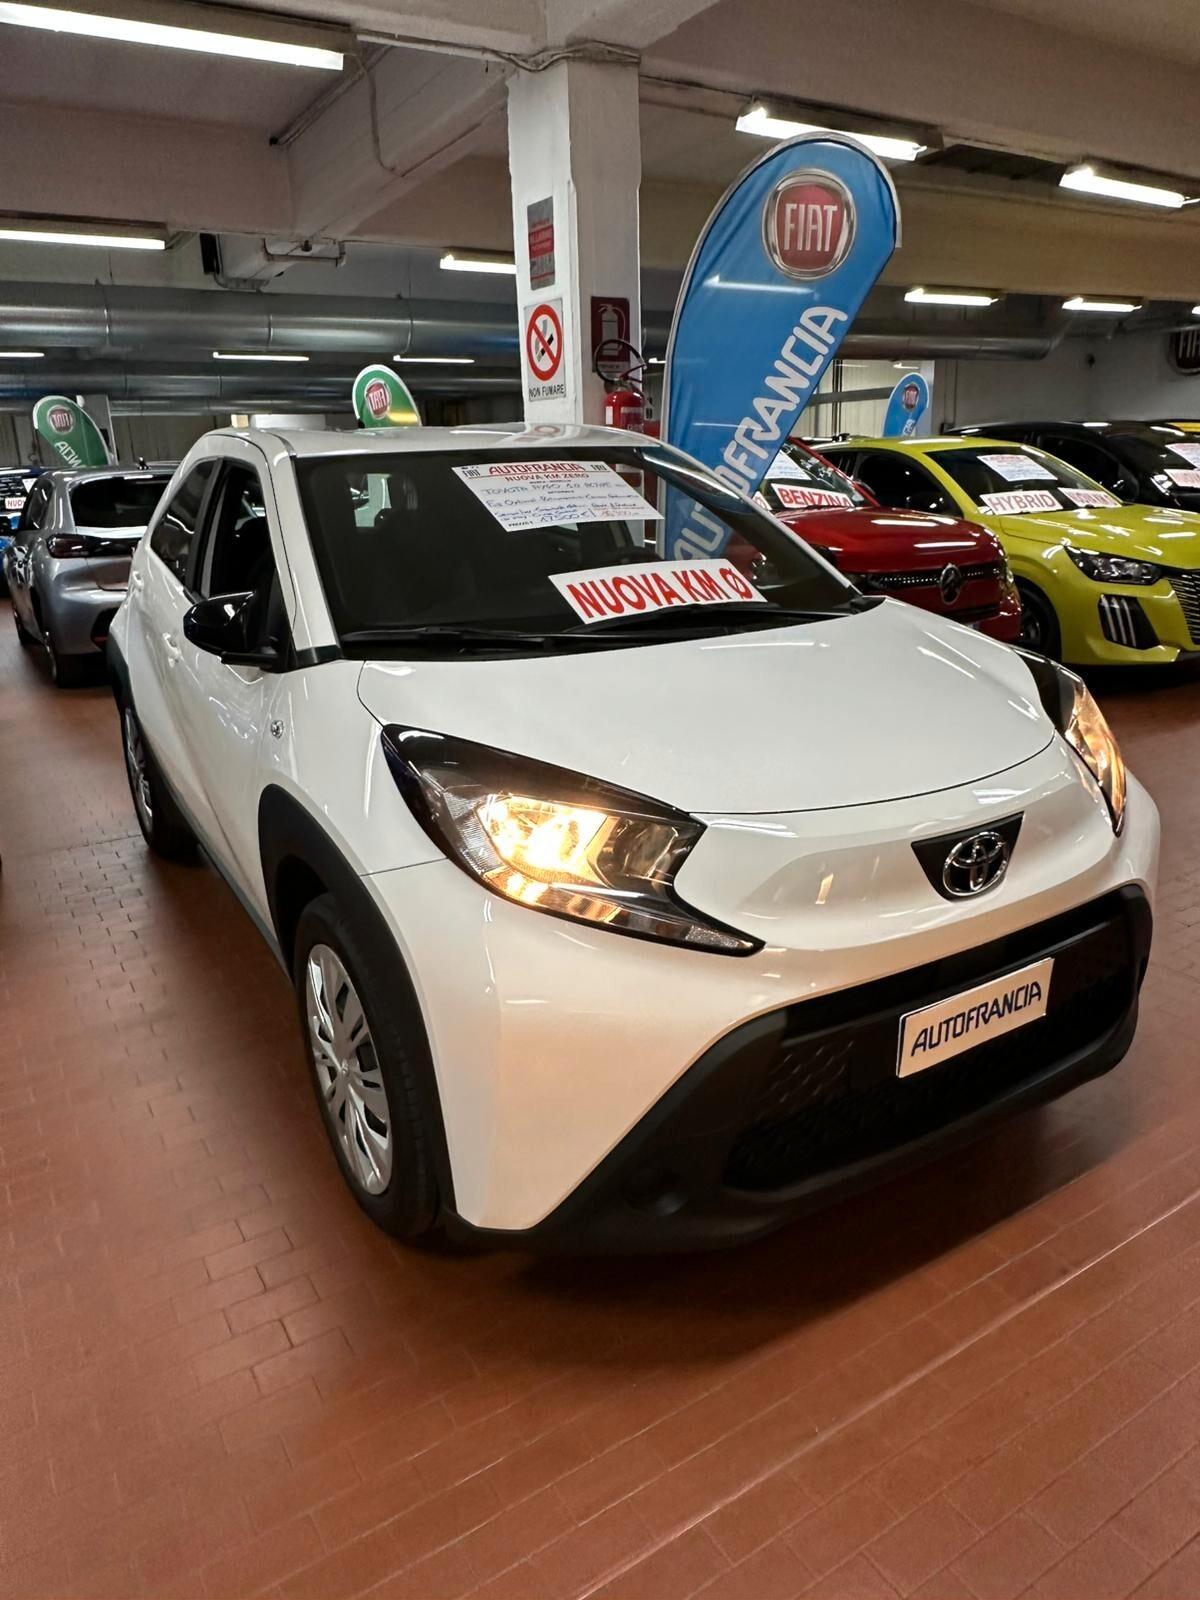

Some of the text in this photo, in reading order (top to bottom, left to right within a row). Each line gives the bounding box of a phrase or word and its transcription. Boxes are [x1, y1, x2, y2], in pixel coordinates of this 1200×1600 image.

[783, 203, 838, 252] FIAT
[529, 384, 564, 398] NON FUMARE
[488, 463, 586, 475] AUTOFRANCIA
[778, 487, 852, 507] BENZINA
[988, 493, 1056, 512] HYBRID
[566, 572, 687, 619] NUOVA
[672, 569, 732, 602] KM
[911, 981, 1042, 1057] AUTOFRANCIA
